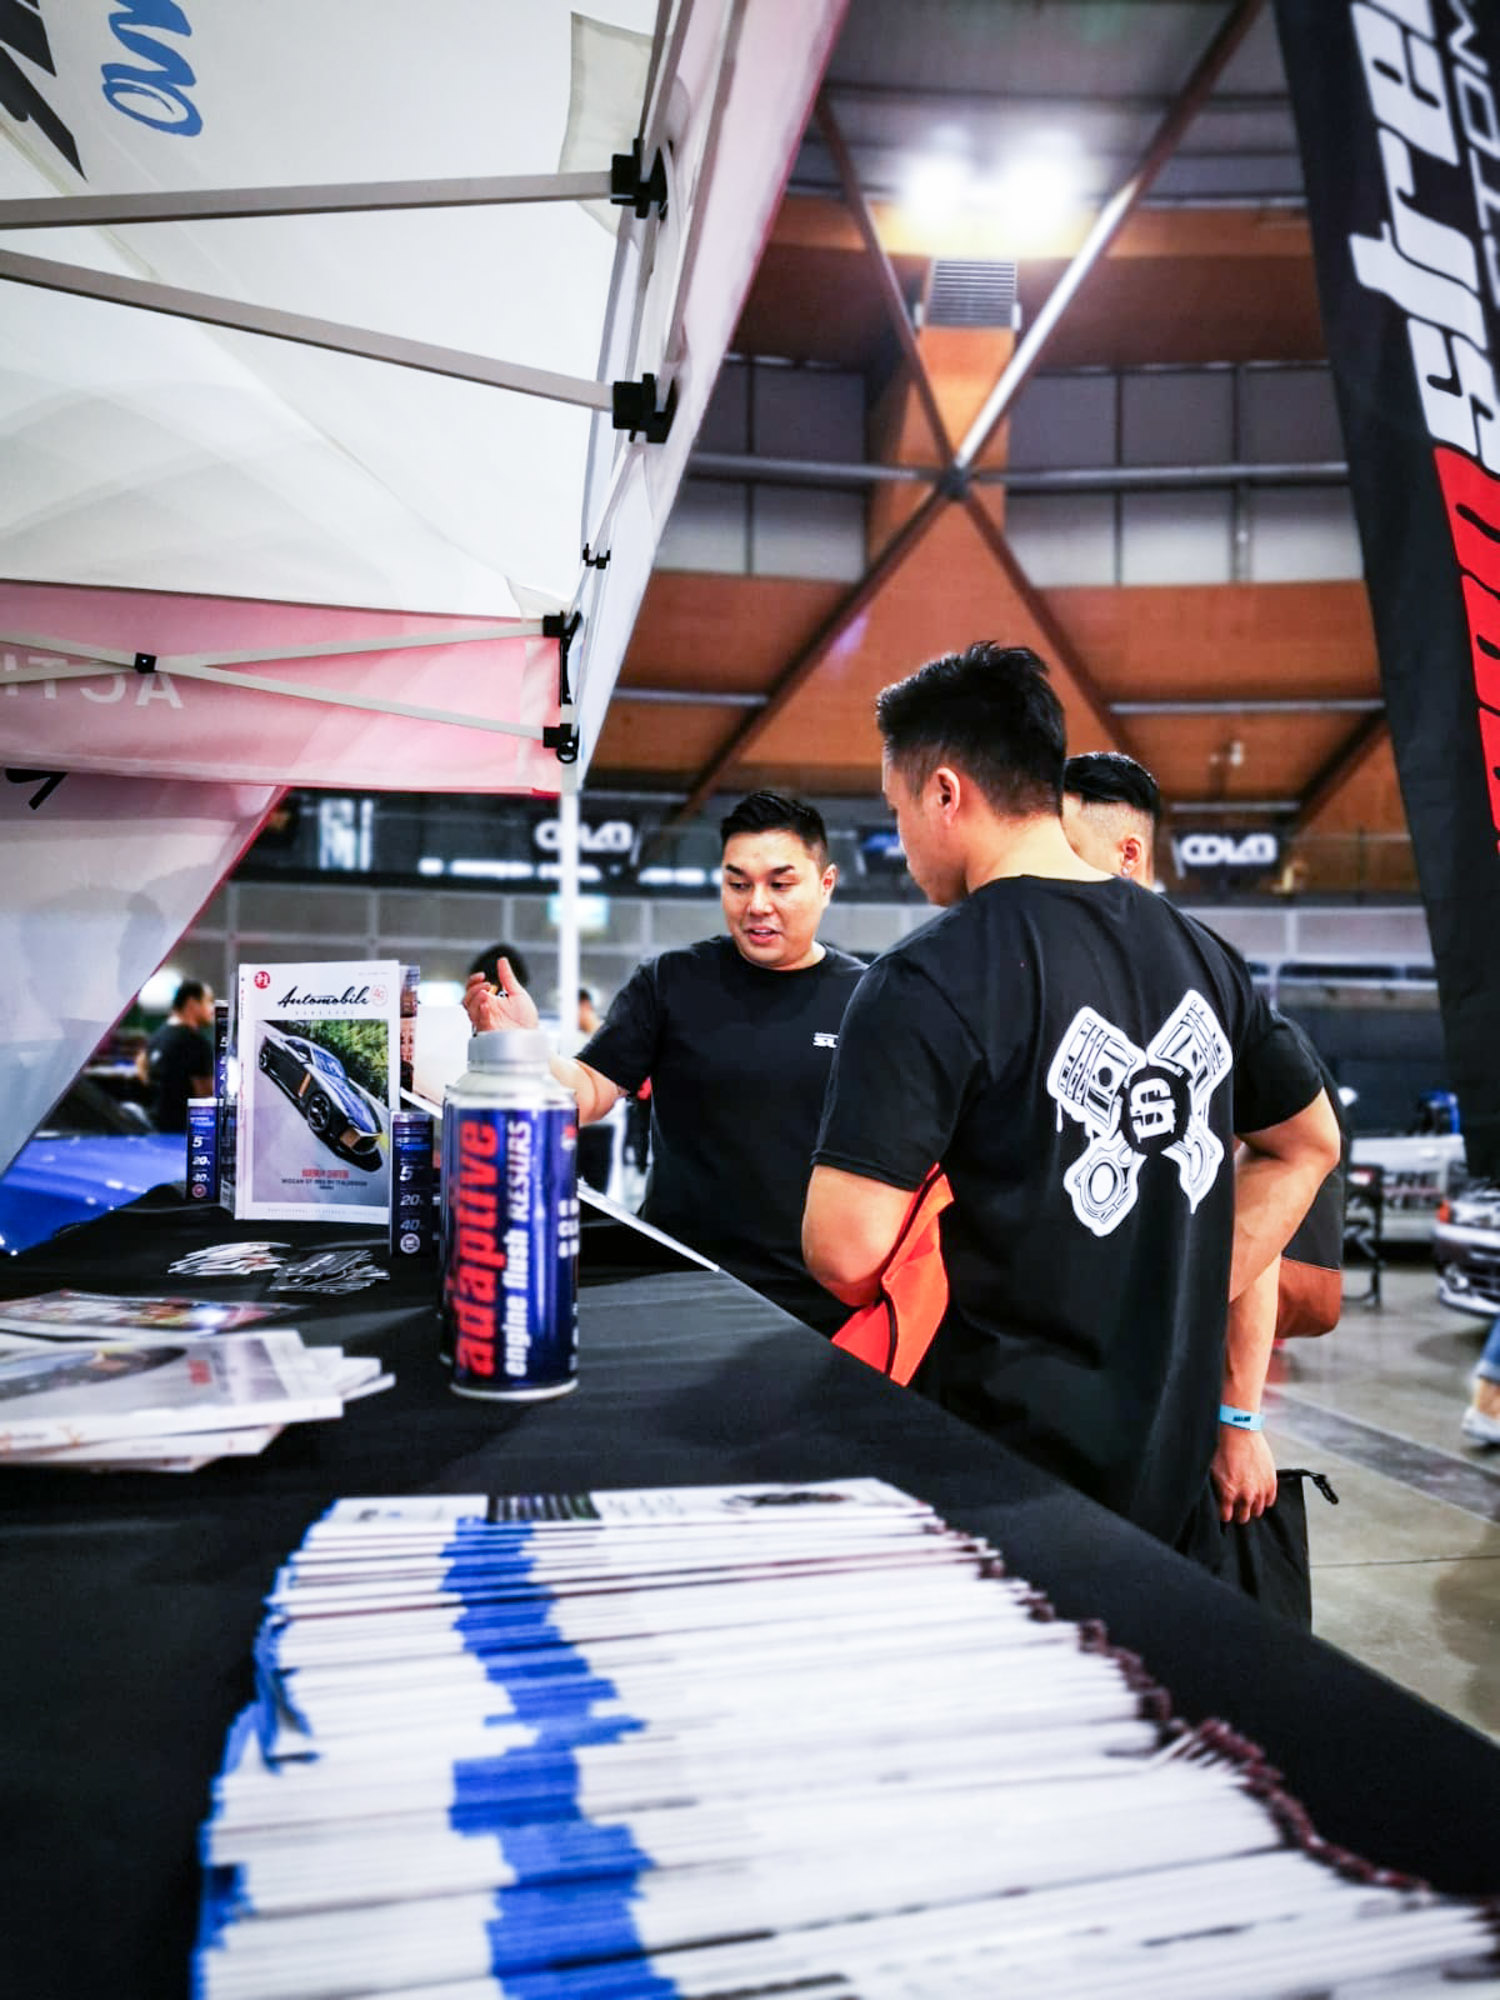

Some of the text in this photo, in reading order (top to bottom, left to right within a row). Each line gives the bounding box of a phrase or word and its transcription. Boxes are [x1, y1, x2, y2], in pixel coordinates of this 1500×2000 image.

[277, 985, 371, 1008] Automobile
[455, 1120, 507, 1377] adaptive
[502, 1228, 529, 1290] flush
[502, 1295, 531, 1377] engine
